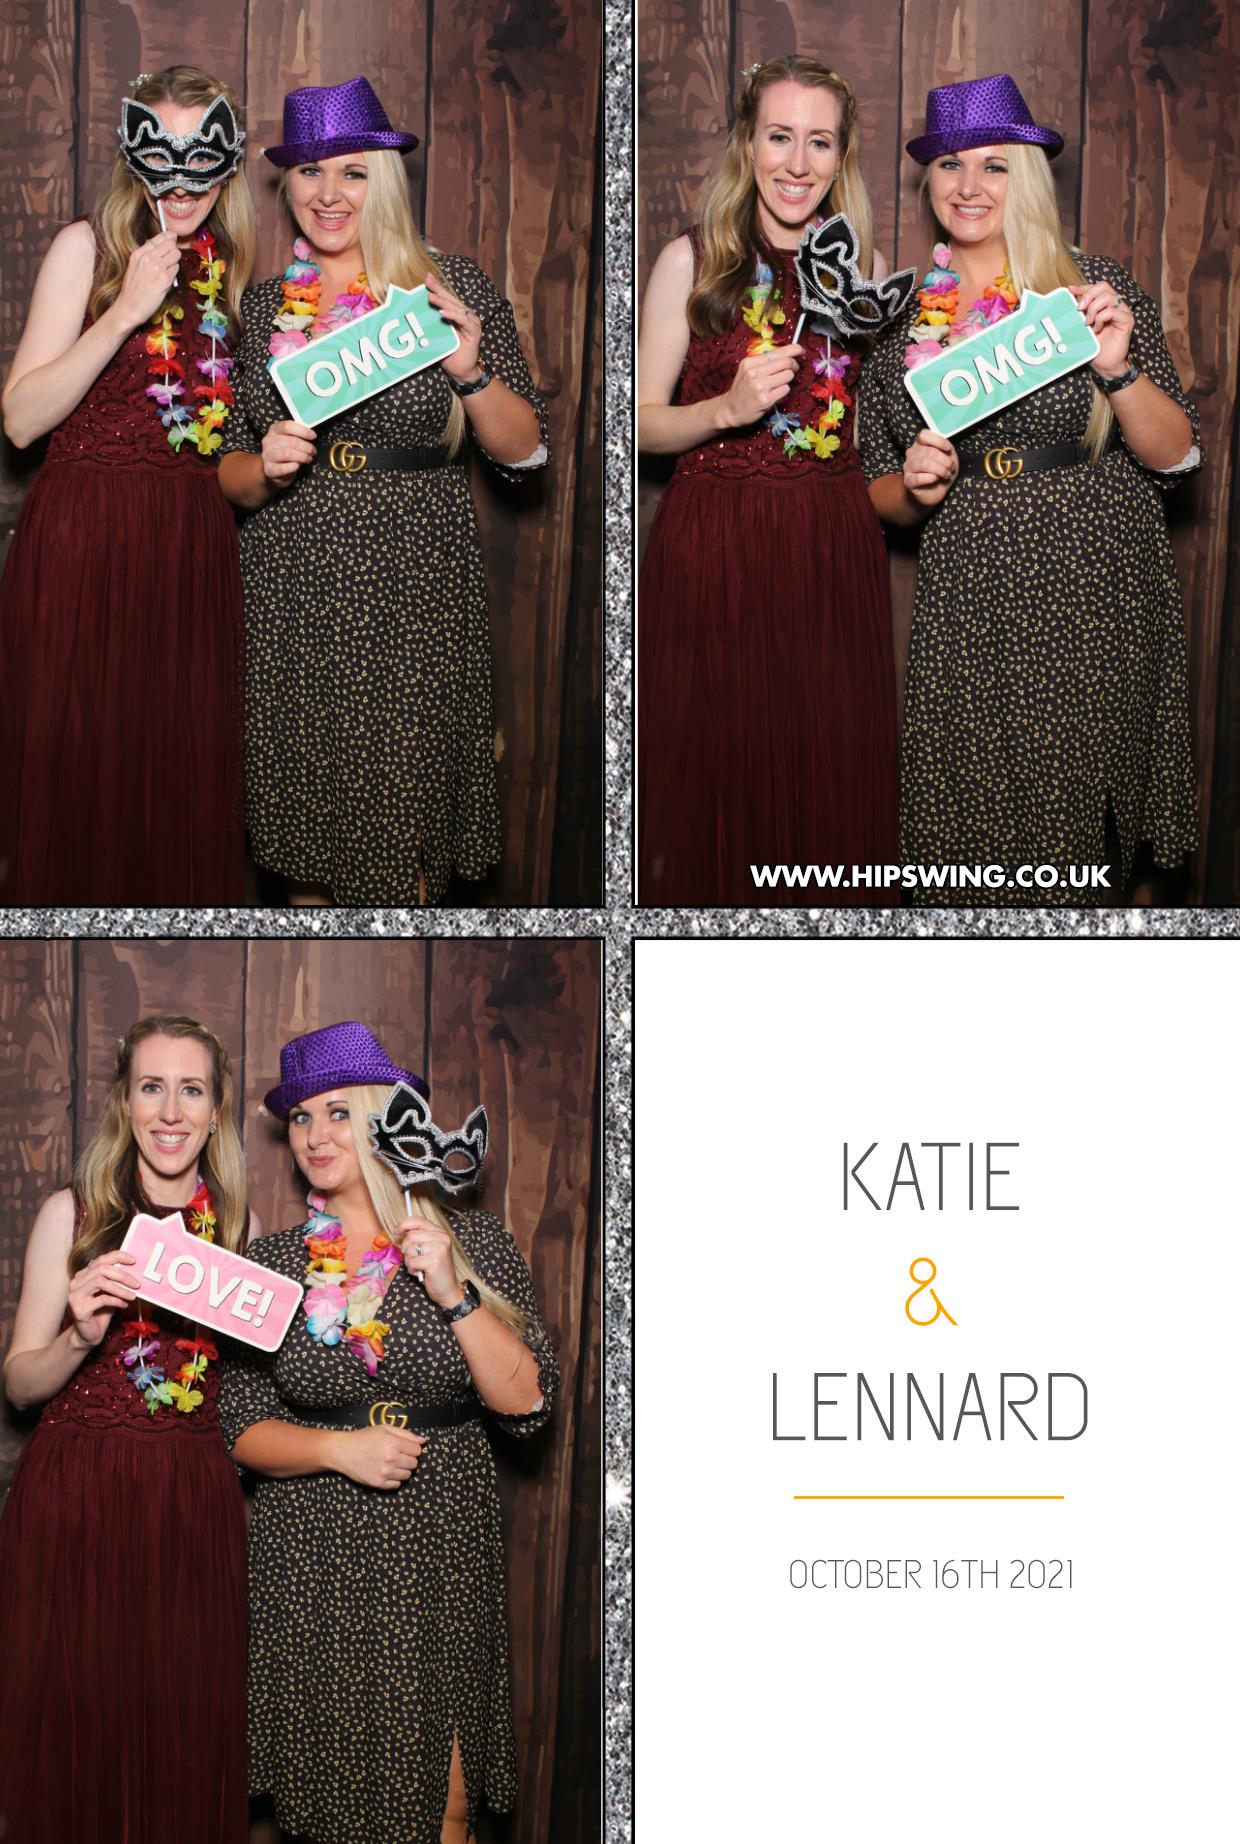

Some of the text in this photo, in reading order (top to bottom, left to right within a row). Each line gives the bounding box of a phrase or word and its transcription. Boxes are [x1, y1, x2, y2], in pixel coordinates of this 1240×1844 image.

[305, 312, 430, 398] OMG!
[940, 317, 1068, 407] OMG!
[142, 1241, 275, 1328] LOVE!
